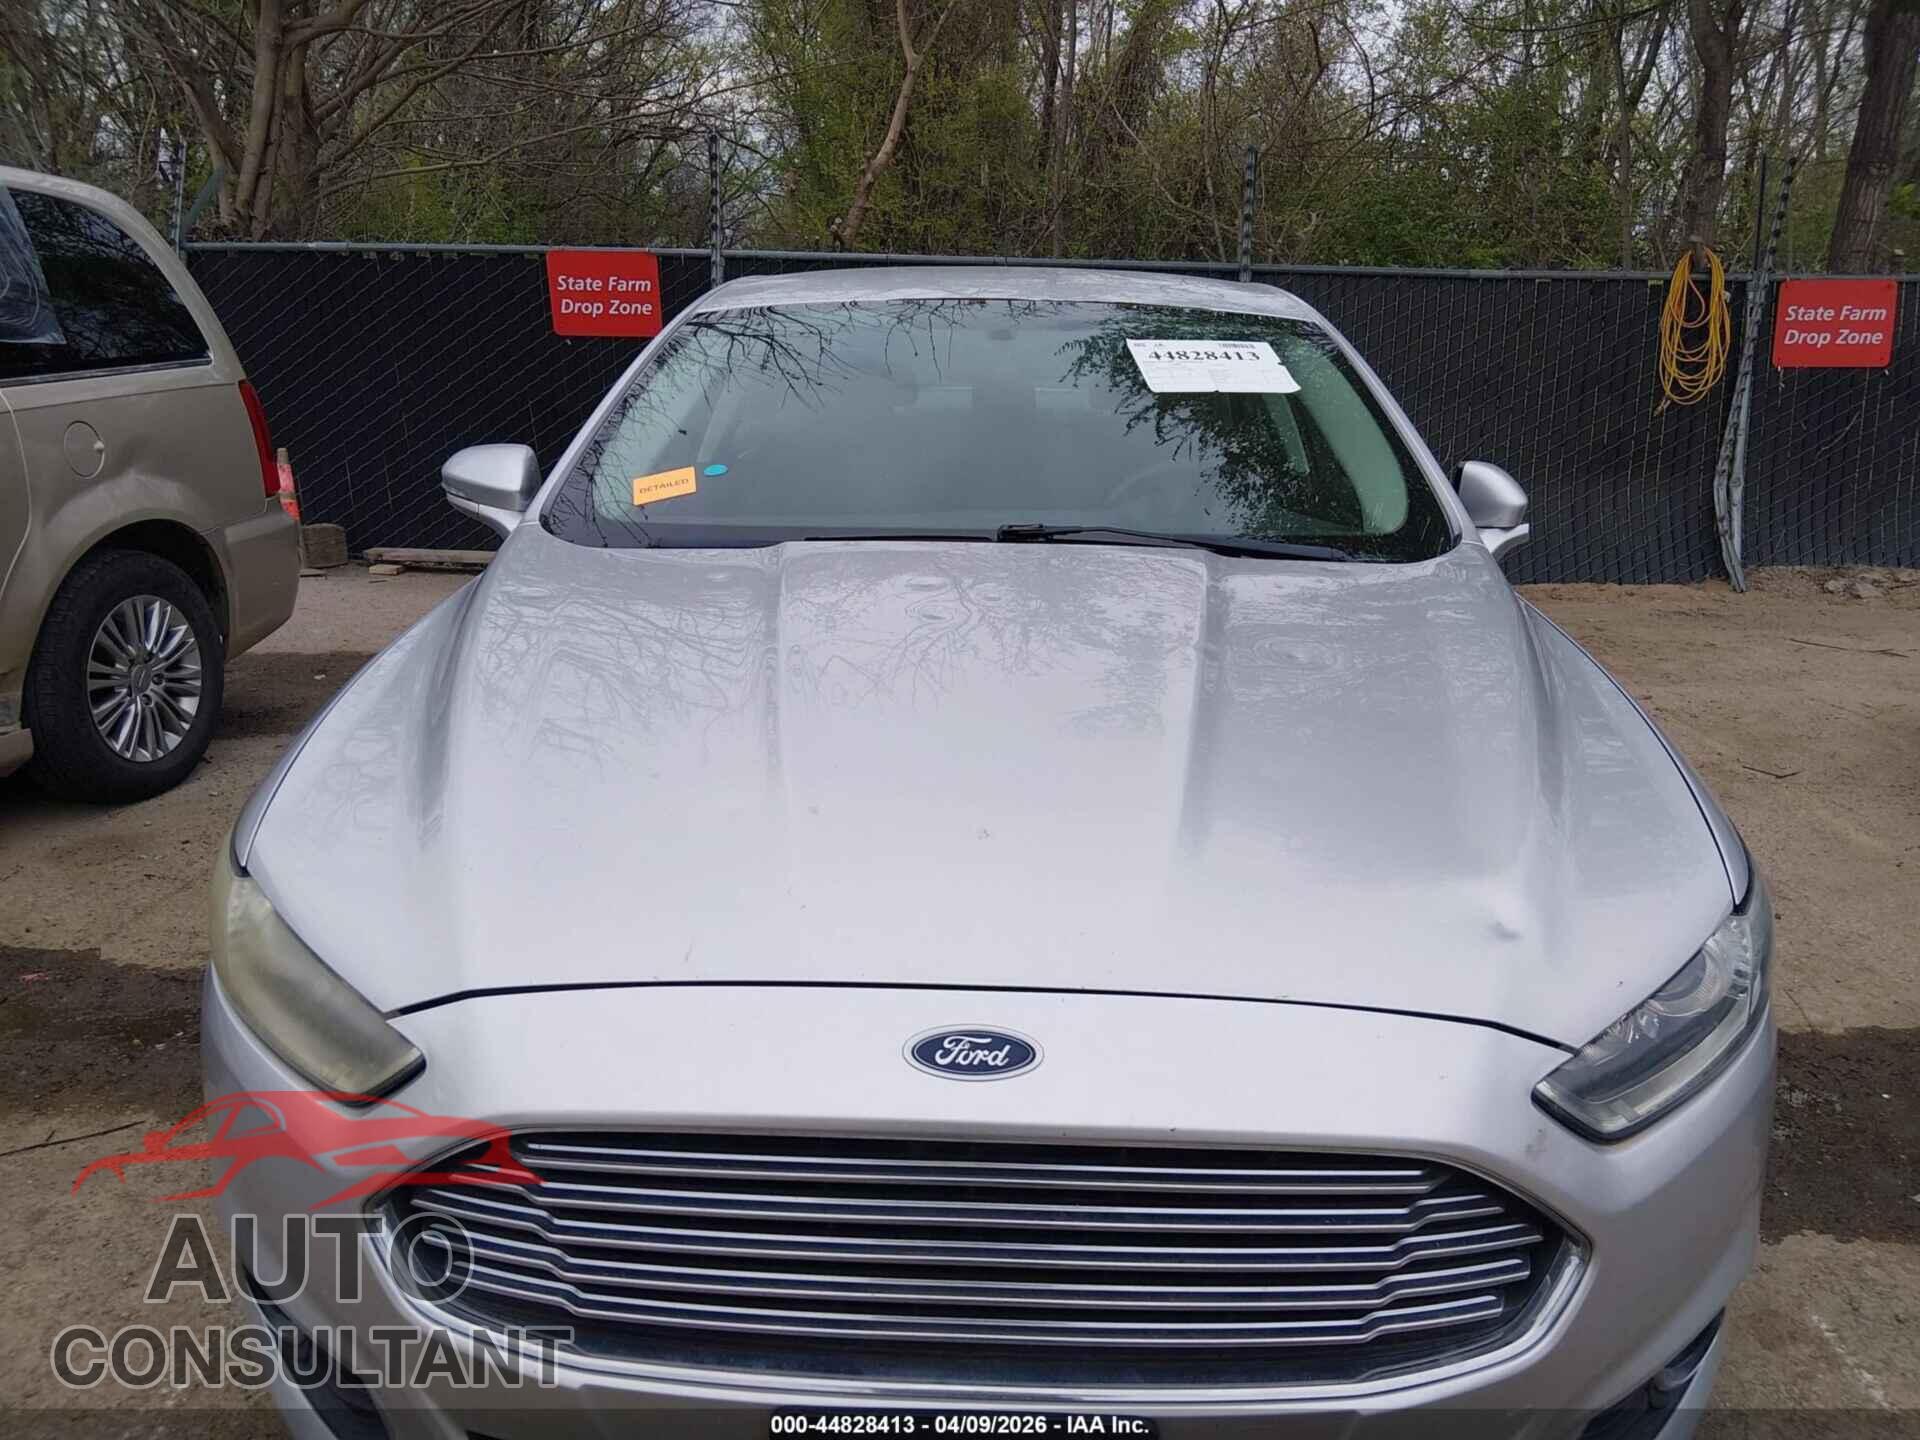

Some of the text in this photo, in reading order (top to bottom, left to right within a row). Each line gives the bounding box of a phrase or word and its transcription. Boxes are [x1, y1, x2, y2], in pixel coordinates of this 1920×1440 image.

[557, 275, 652, 292] State Farm
[560, 299, 653, 318] Drop Zone
[1785, 305, 1888, 321] State Farm
[1783, 329, 1884, 348] Drop Zone
[1148, 350, 1261, 361] 44828413
[639, 478, 689, 494] DETAILED
[934, 1035, 1012, 1066] Ford
